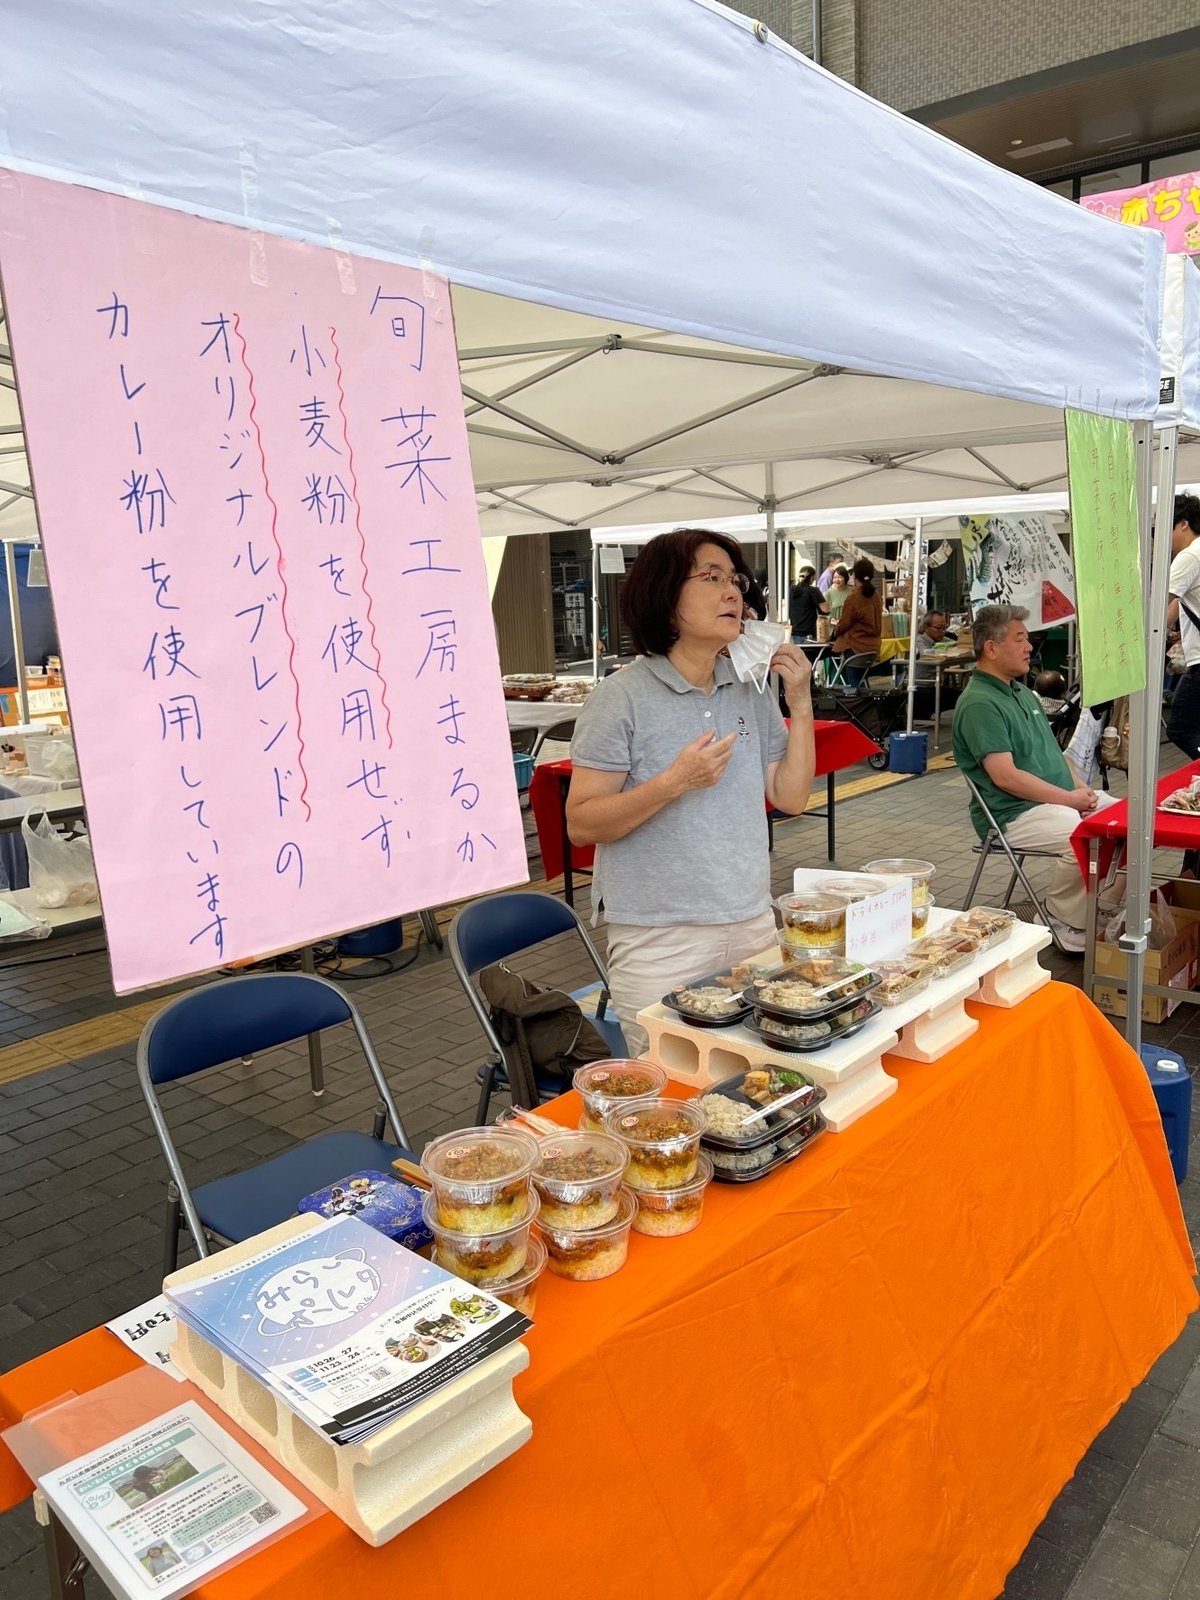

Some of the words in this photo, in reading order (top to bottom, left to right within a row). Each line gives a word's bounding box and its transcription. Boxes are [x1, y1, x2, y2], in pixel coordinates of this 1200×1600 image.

[96, 292, 227, 958] カレー粉を使用しています
[200, 312, 304, 889] オリジナルブレンドの
[370, 286, 498, 865] 旬菜工房まるか
